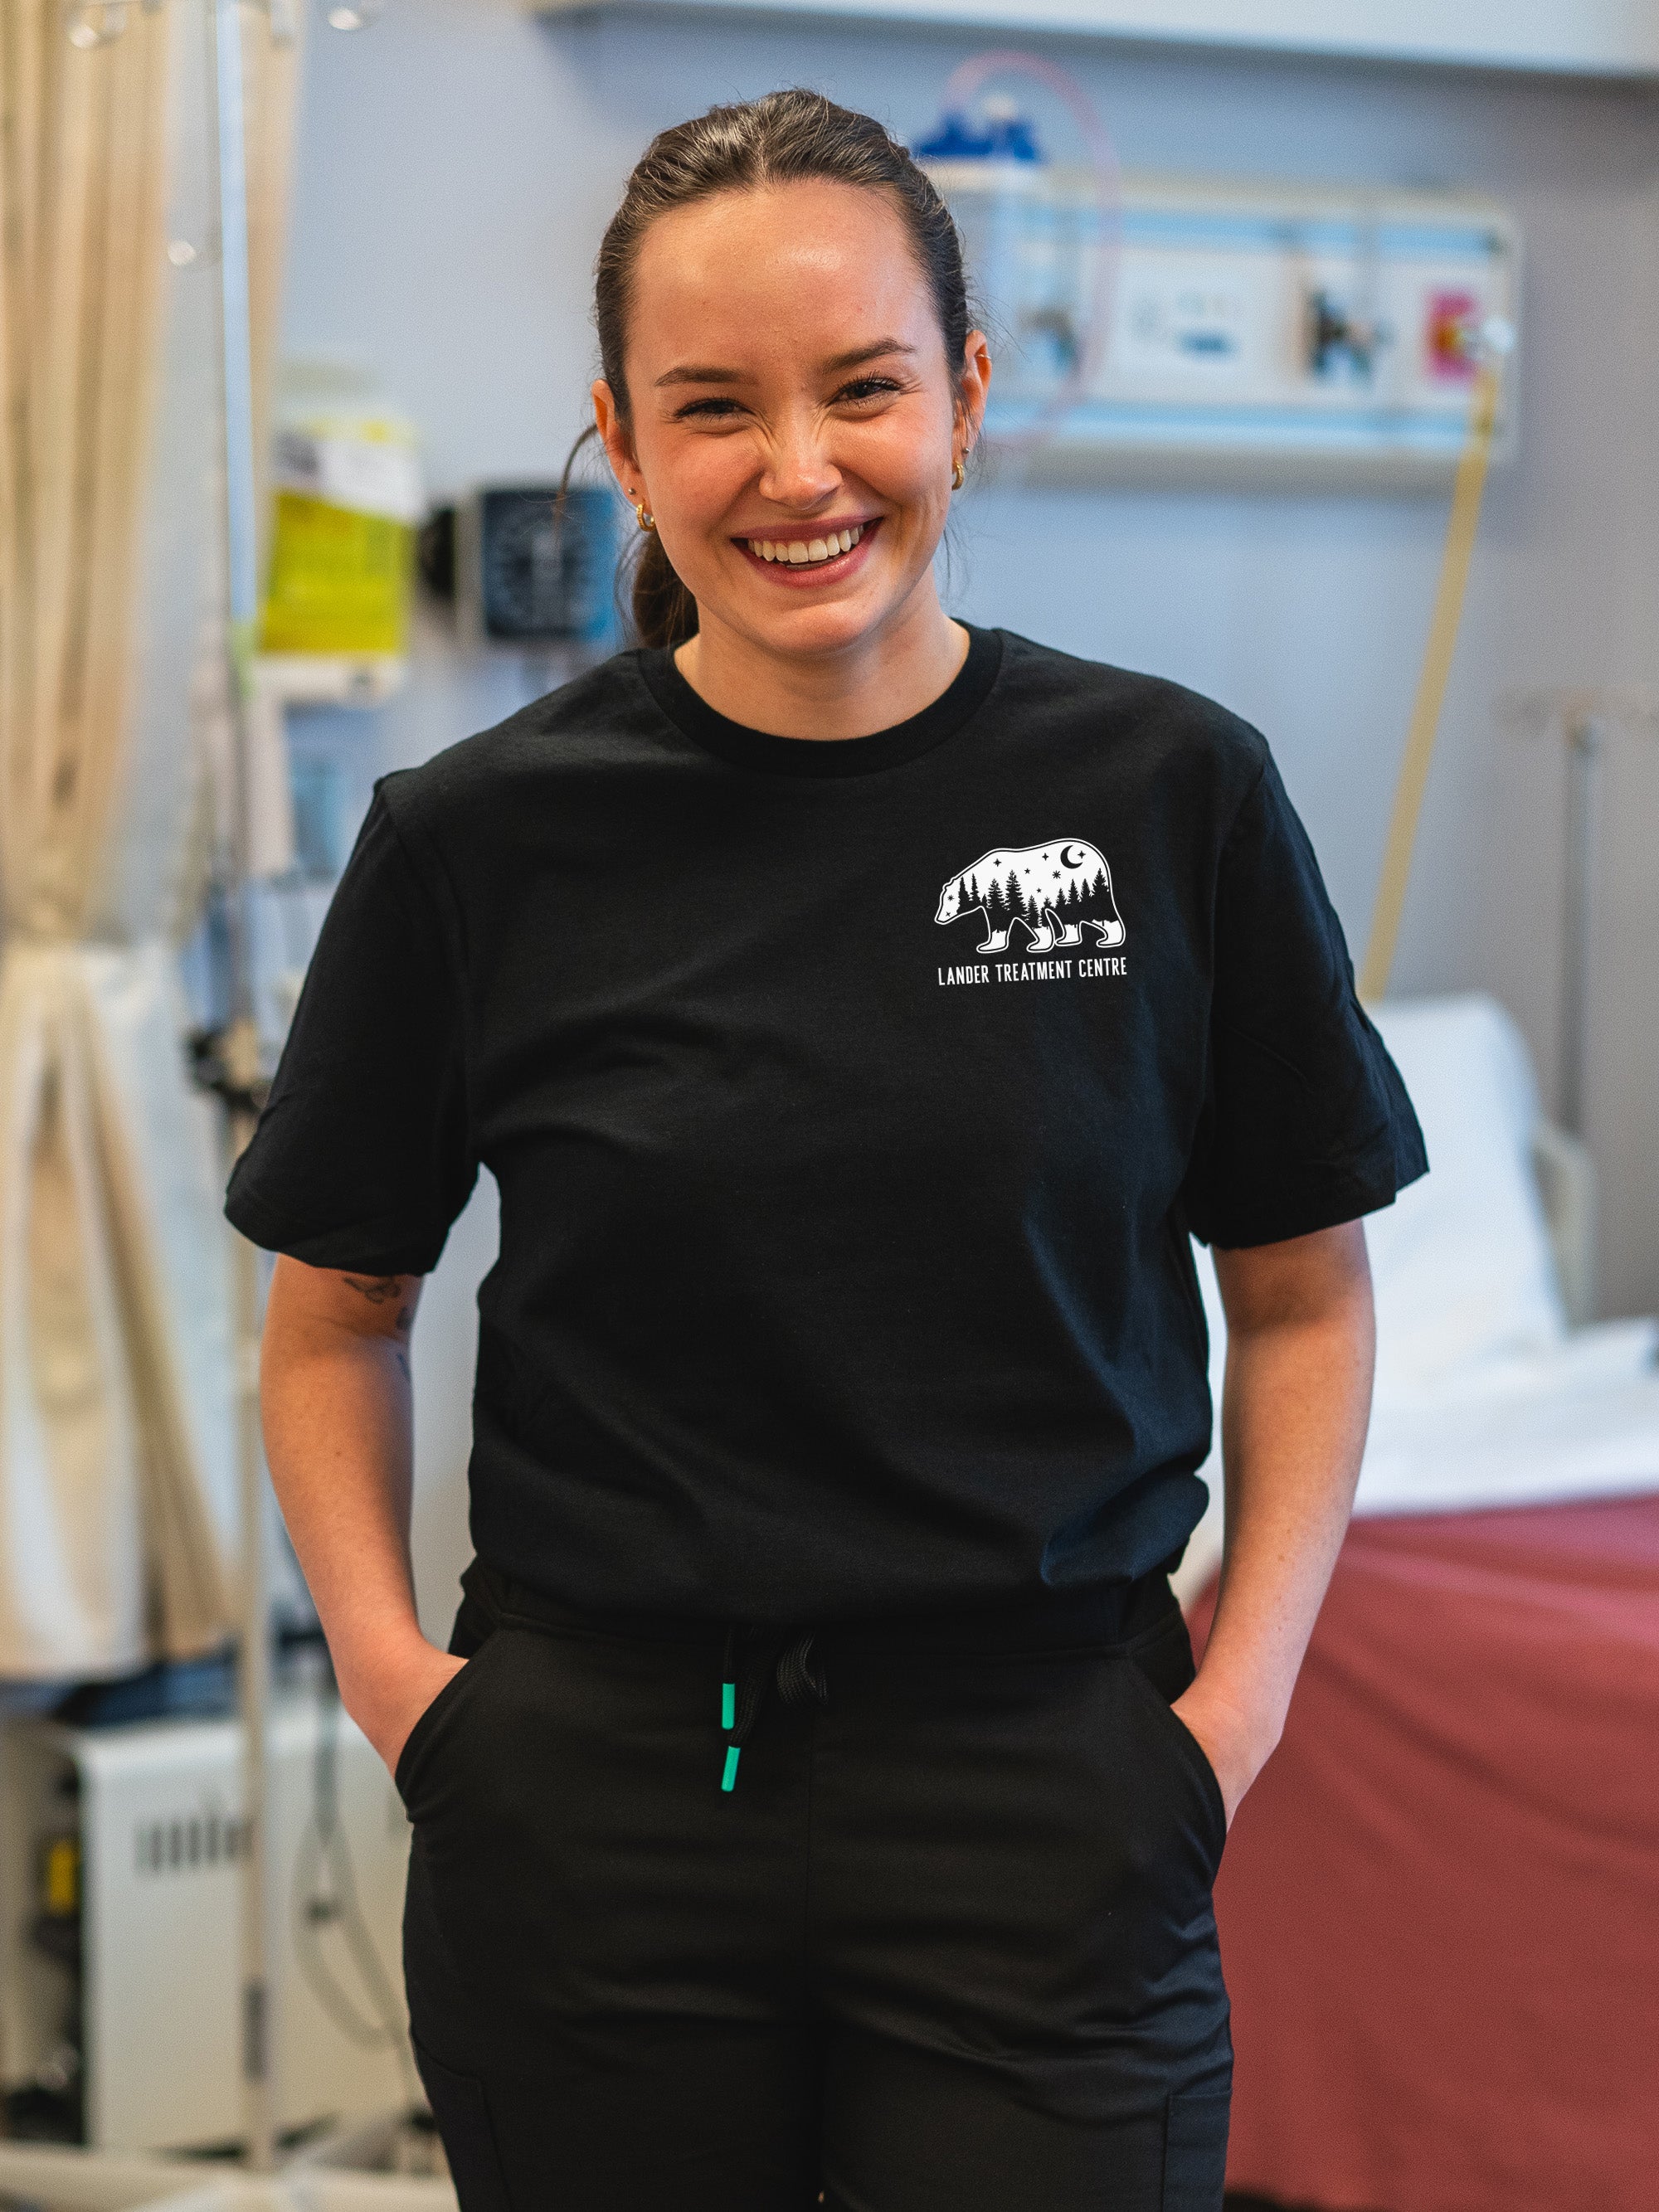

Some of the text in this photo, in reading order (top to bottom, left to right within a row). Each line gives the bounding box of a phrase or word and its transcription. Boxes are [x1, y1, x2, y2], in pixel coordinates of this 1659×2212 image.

[938, 957, 1127, 985] LANDER TREATMENT CENTRE
